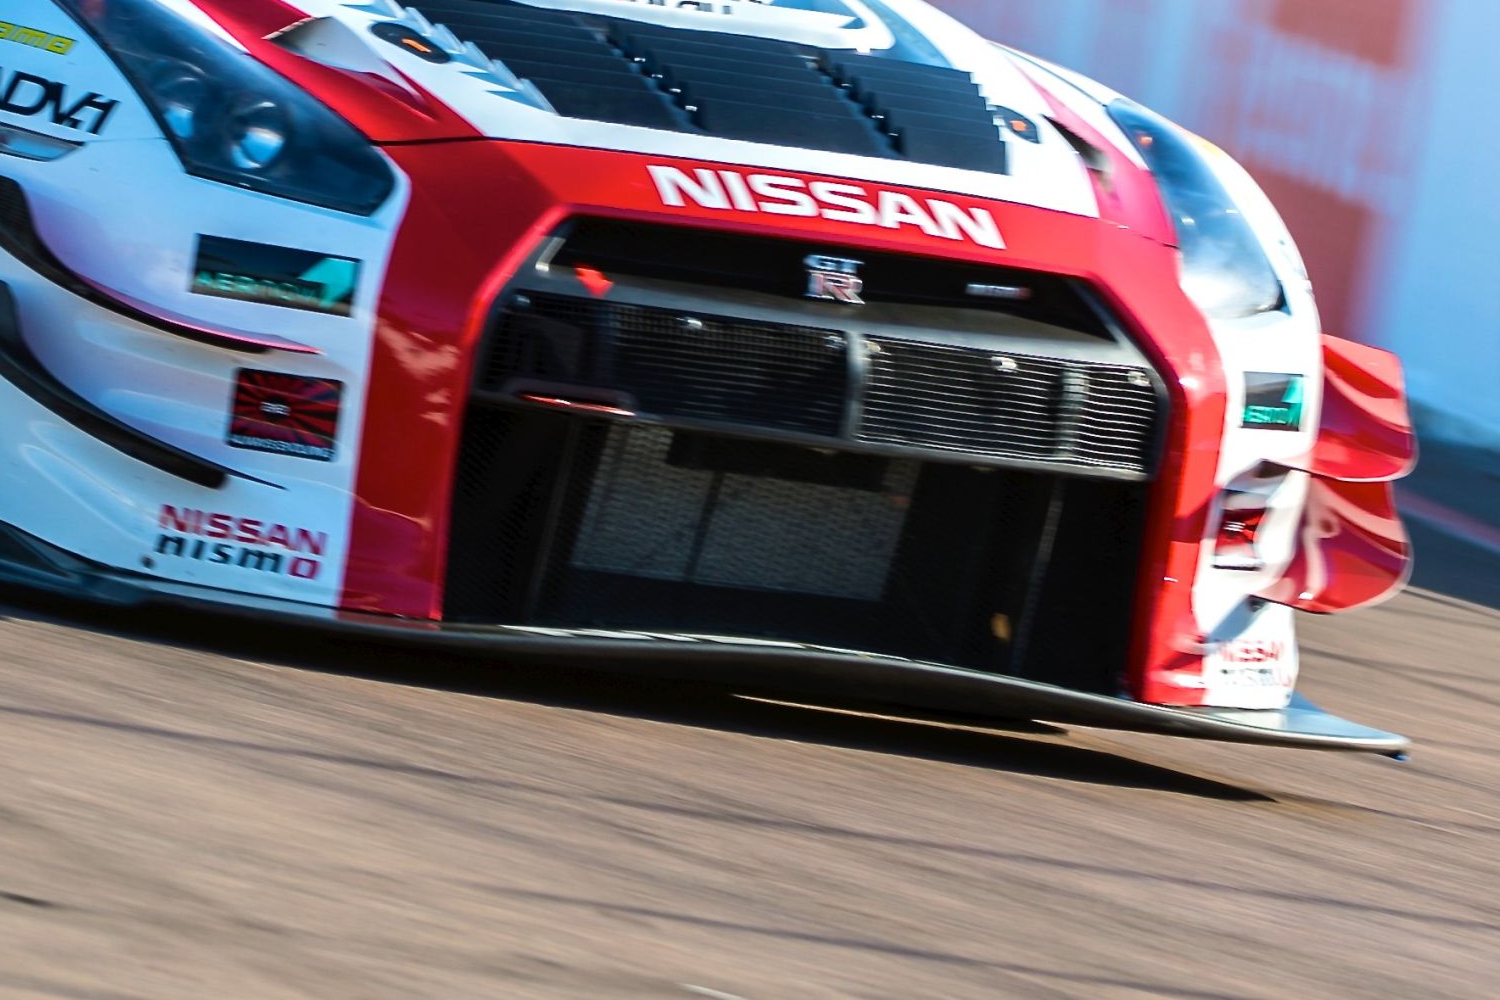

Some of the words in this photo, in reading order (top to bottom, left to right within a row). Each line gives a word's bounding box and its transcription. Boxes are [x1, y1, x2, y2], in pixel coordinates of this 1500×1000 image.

[646, 165, 1007, 250] NISSAN
[160, 503, 328, 556] NISSAN
[154, 534, 322, 580] nismo
